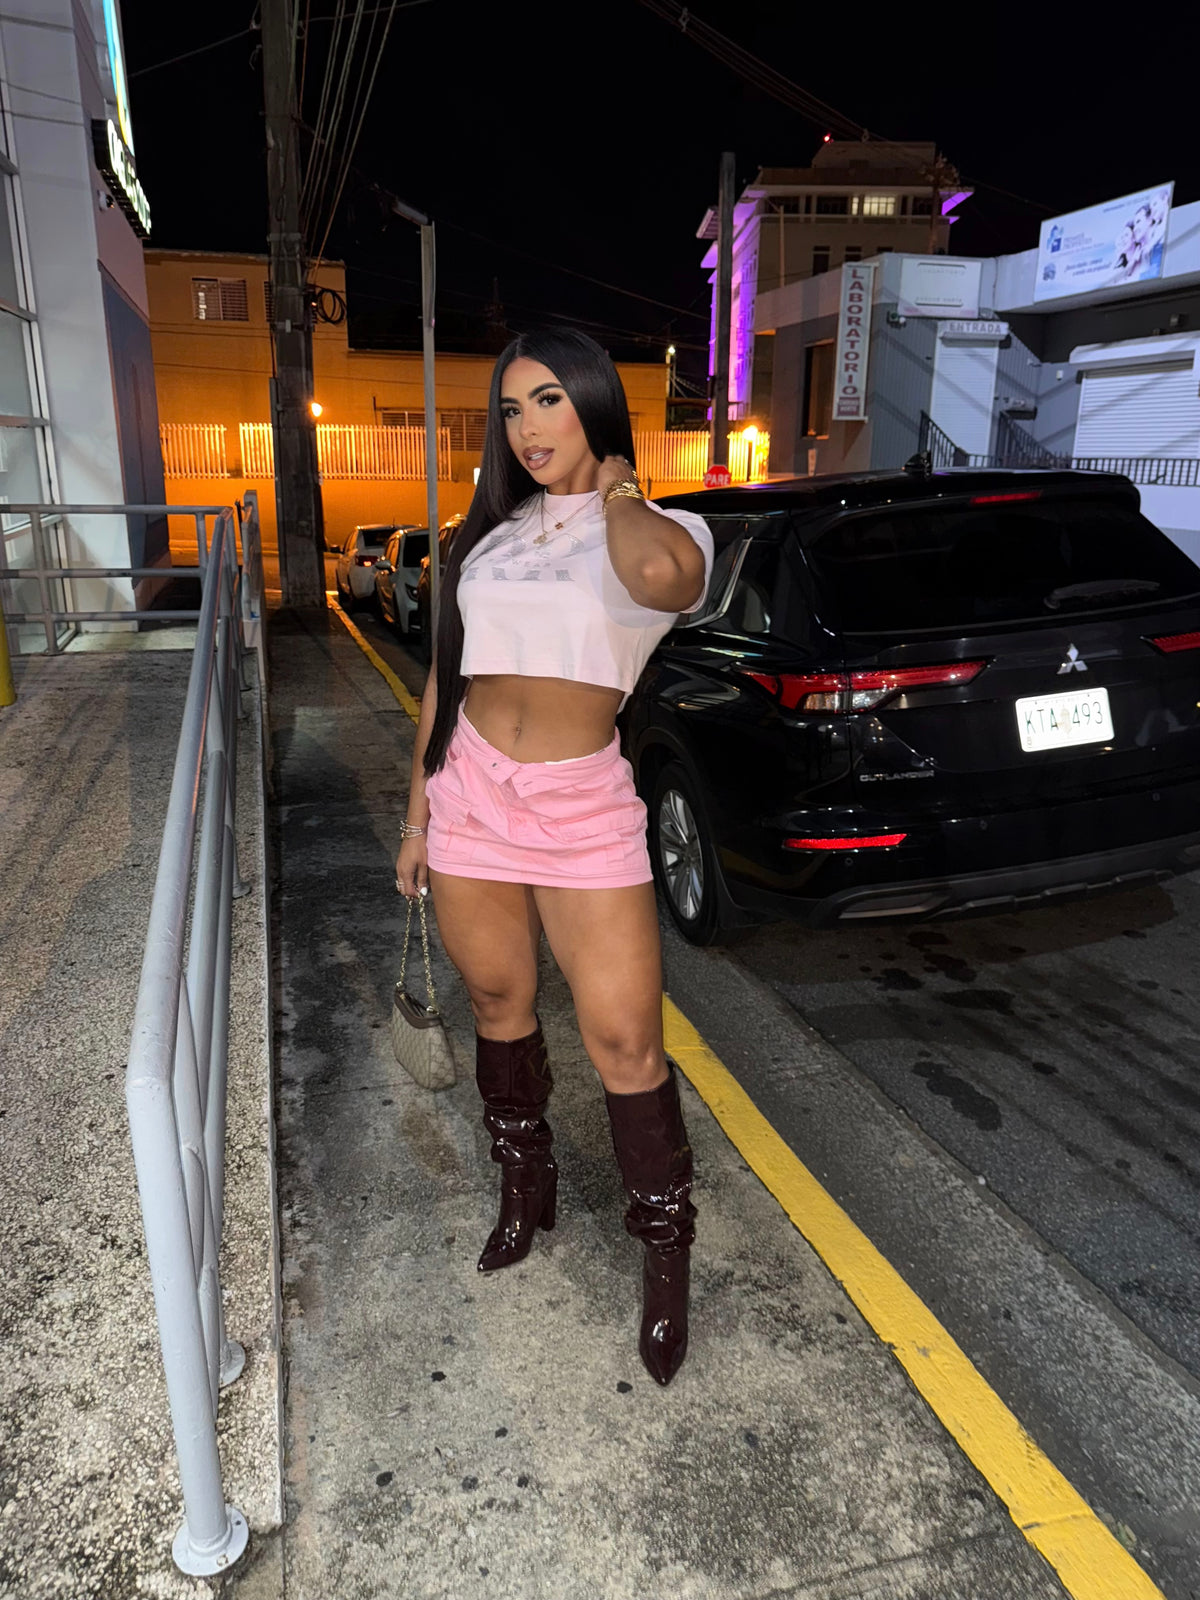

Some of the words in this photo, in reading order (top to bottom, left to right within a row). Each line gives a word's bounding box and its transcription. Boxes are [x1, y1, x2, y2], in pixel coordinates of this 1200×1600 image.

[842, 268, 865, 395] LABORATORIO
[948, 322, 1002, 333] ENTRADA
[705, 473, 730, 486] PARE
[1025, 707, 1060, 735] KTA
[1072, 701, 1103, 727] 493
[860, 769, 935, 782] OUTLANDER
